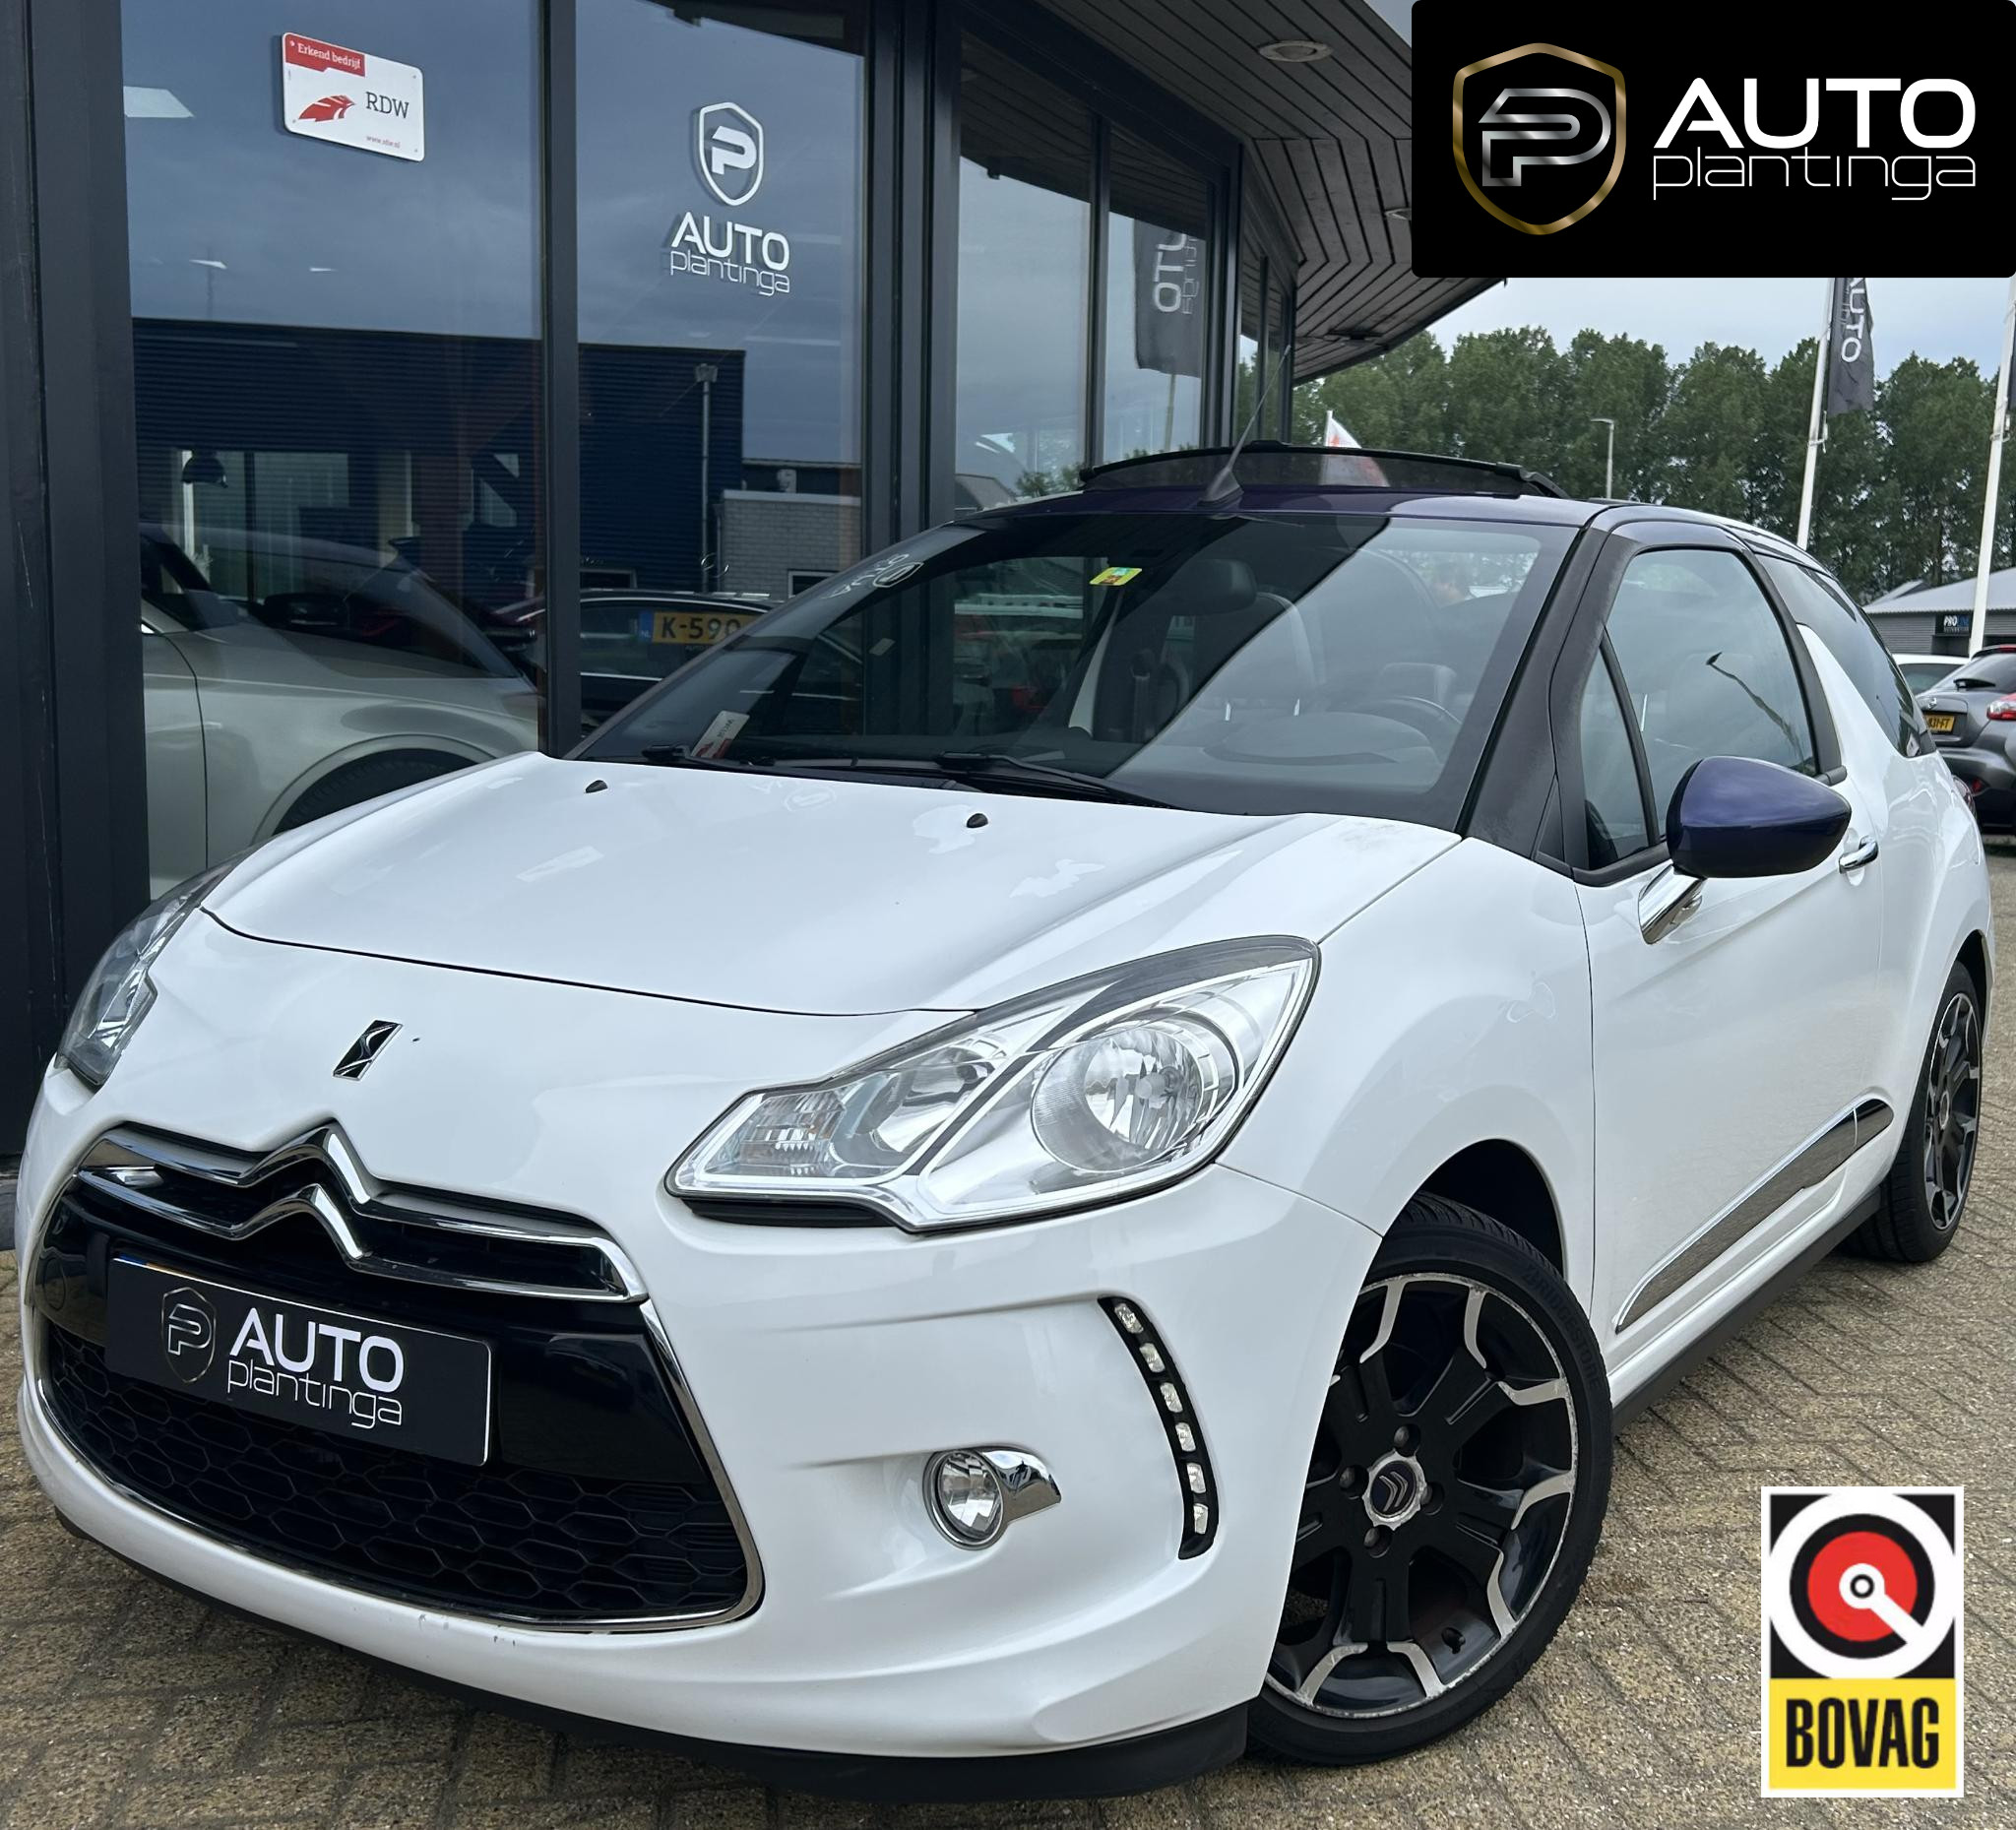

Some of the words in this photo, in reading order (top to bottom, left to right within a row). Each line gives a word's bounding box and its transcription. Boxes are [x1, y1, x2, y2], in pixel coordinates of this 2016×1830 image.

[297, 42, 331, 61] Erkend
[332, 51, 361, 70] bedrijf
[365, 91, 410, 119] RDW
[670, 211, 789, 272] AUTO
[670, 249, 790, 296] plantinga
[228, 1307, 405, 1393] AUTO
[226, 1358, 403, 1429] plantinga
